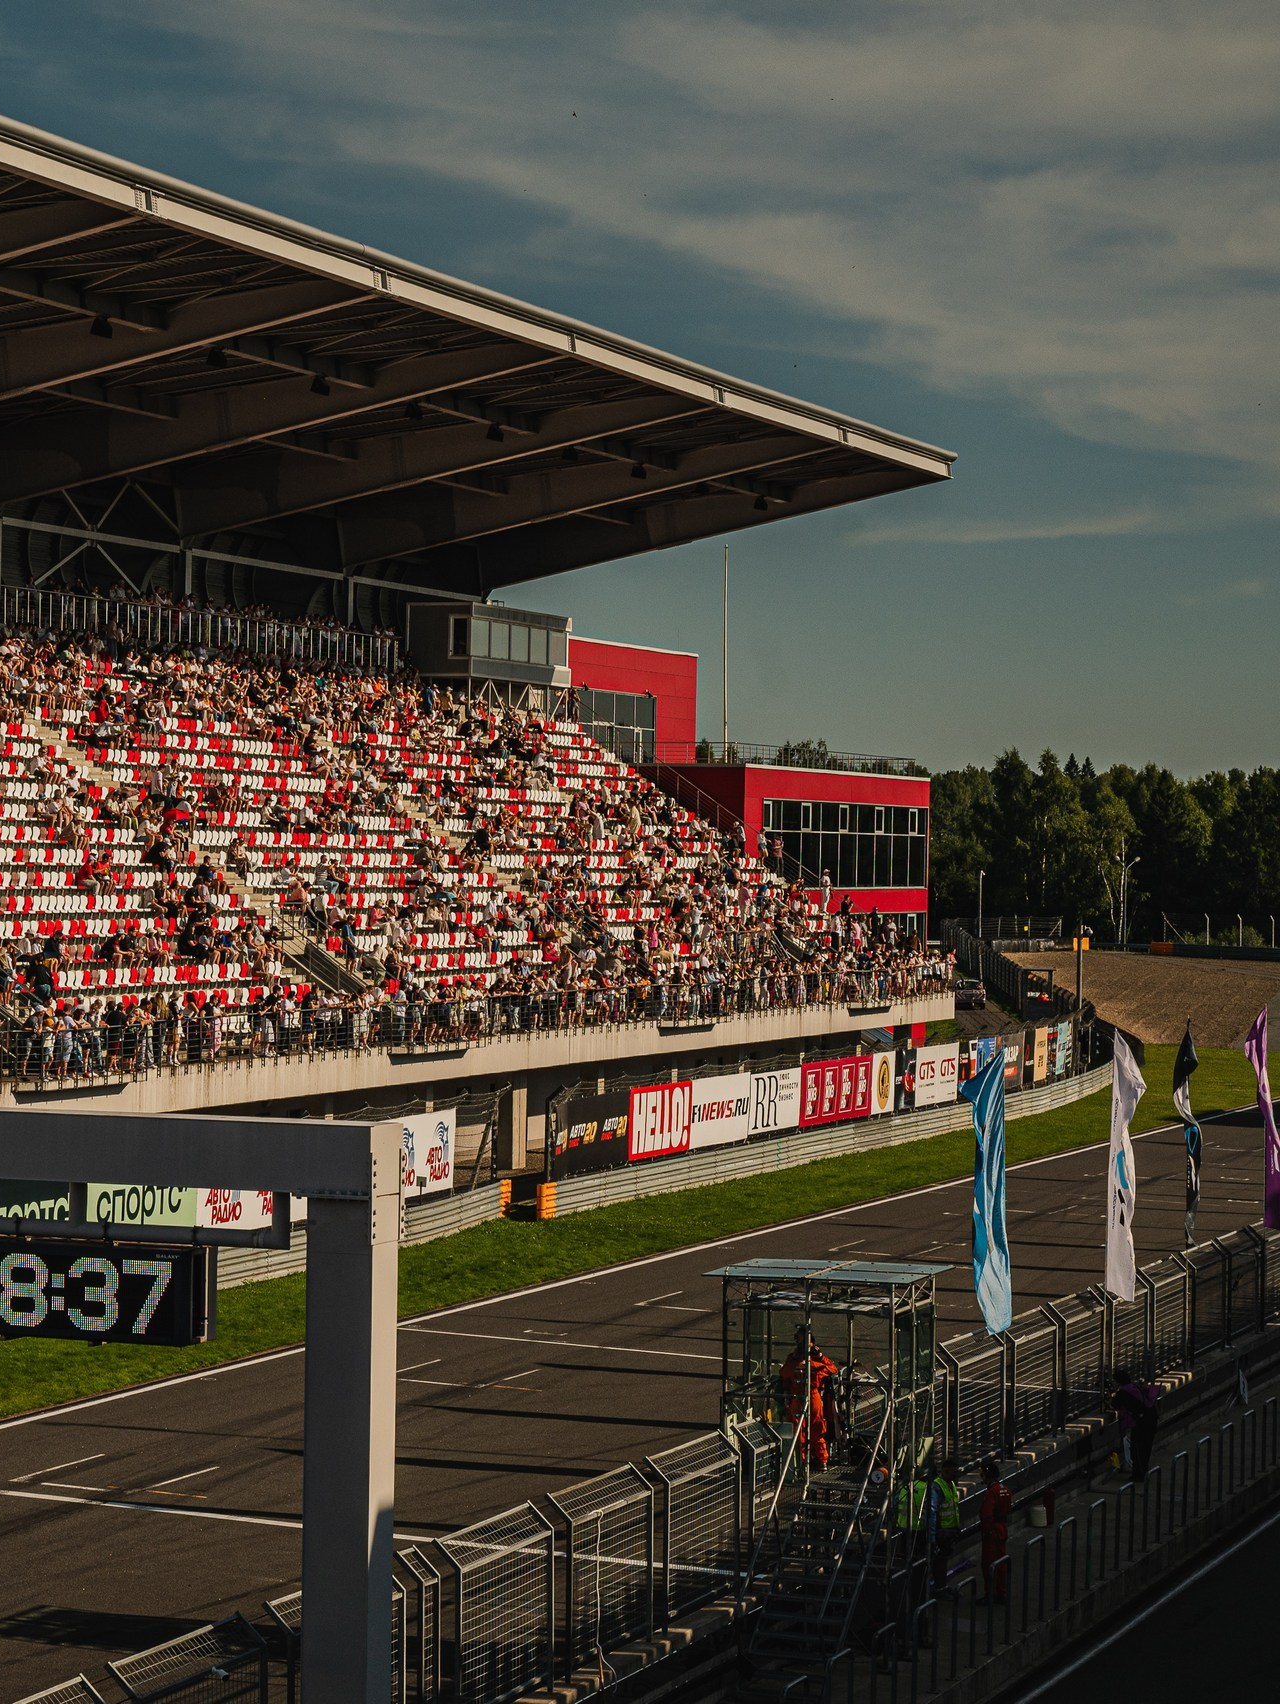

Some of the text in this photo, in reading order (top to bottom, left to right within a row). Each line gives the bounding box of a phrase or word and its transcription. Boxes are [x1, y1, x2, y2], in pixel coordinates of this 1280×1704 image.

[919, 1061, 936, 1080] GTS
[940, 1058, 956, 1077] GTS
[692, 1097, 750, 1123] F1NEWS.RU
[752, 1075, 779, 1130] RR
[602, 1115, 628, 1138] АВТО 20
[631, 1086, 690, 1155] HELLO!
[569, 1123, 586, 1139] АВТО
[583, 1121, 598, 1144] 20
[426, 1146, 443, 1165] АВТО
[429, 1162, 450, 1182] РАДИО
[205, 1188, 231, 1207] АВТО
[211, 1202, 242, 1225] РАДИО
